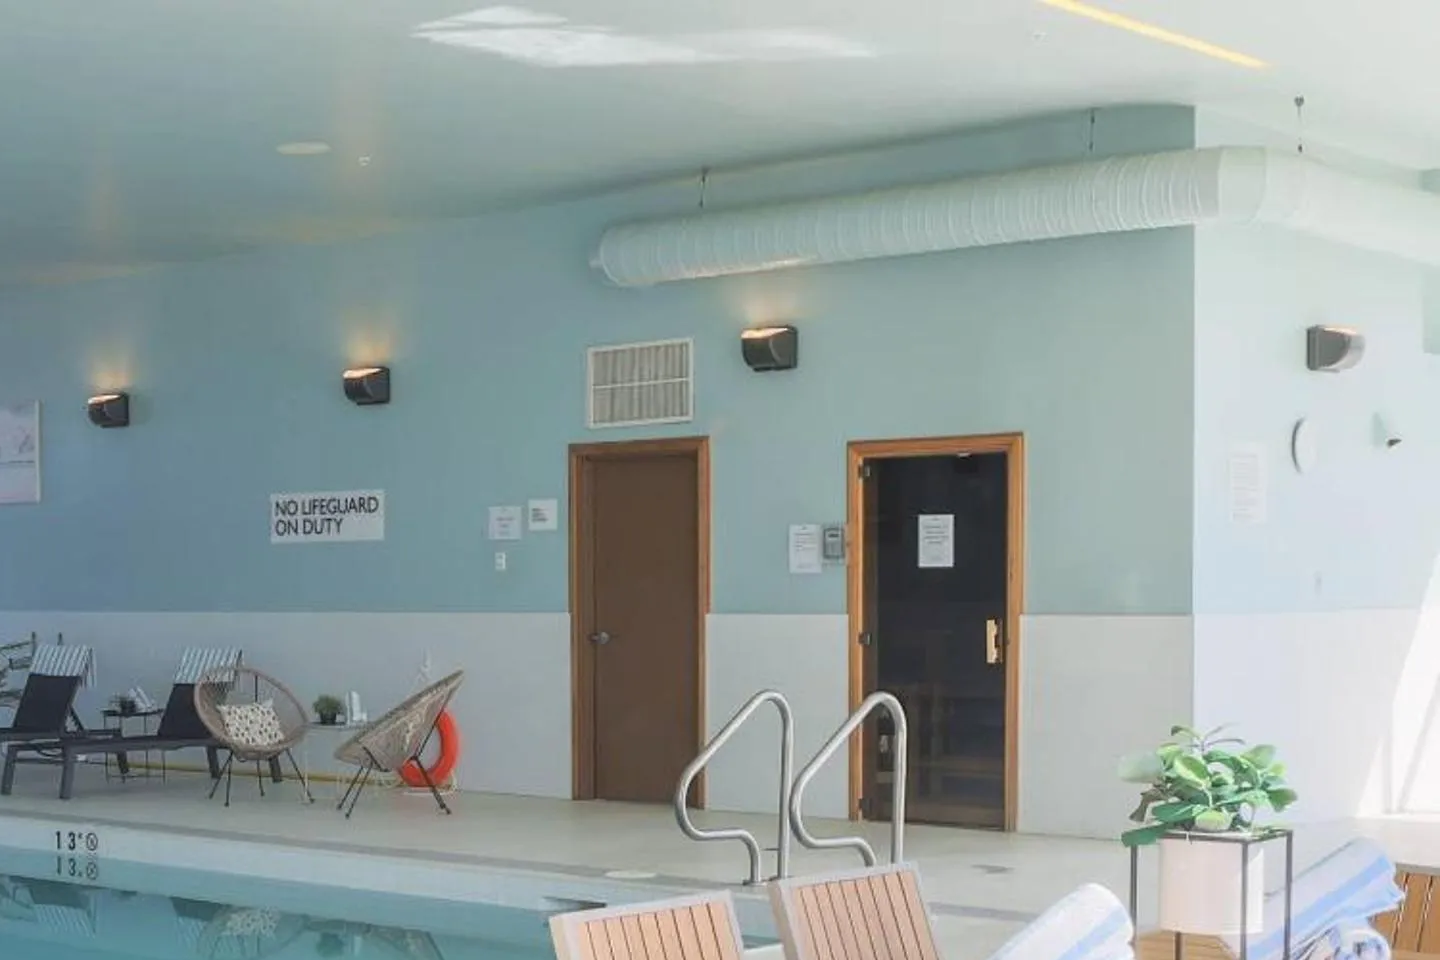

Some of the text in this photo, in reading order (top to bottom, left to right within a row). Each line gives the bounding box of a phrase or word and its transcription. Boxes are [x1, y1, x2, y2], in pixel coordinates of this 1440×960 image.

[274, 496, 380, 516] NO LIFEGUARD
[275, 518, 344, 536] ON DUTY
